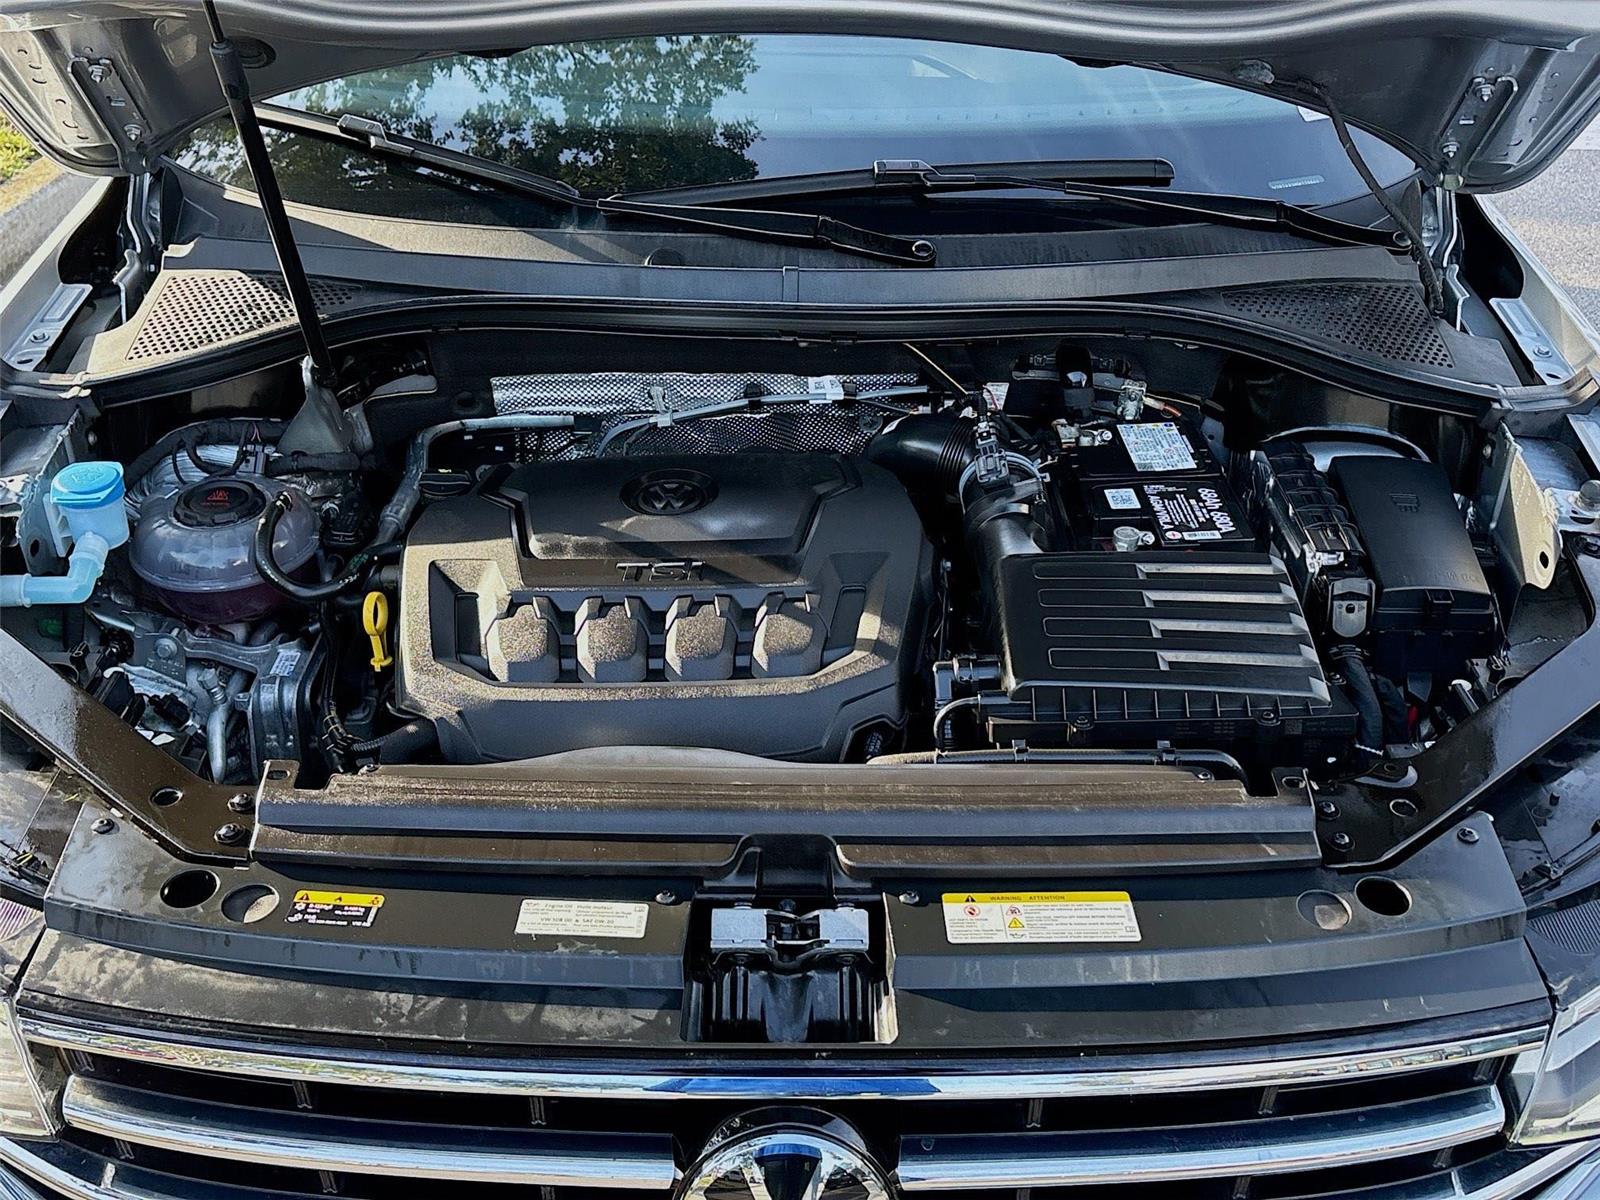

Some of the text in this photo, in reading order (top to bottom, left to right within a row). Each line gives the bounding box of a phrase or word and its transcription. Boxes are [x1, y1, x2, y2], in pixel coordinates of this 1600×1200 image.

[1198, 488, 1223, 510] 68Ah
[1210, 511, 1236, 533] 680A
[616, 561, 706, 581] TSI
